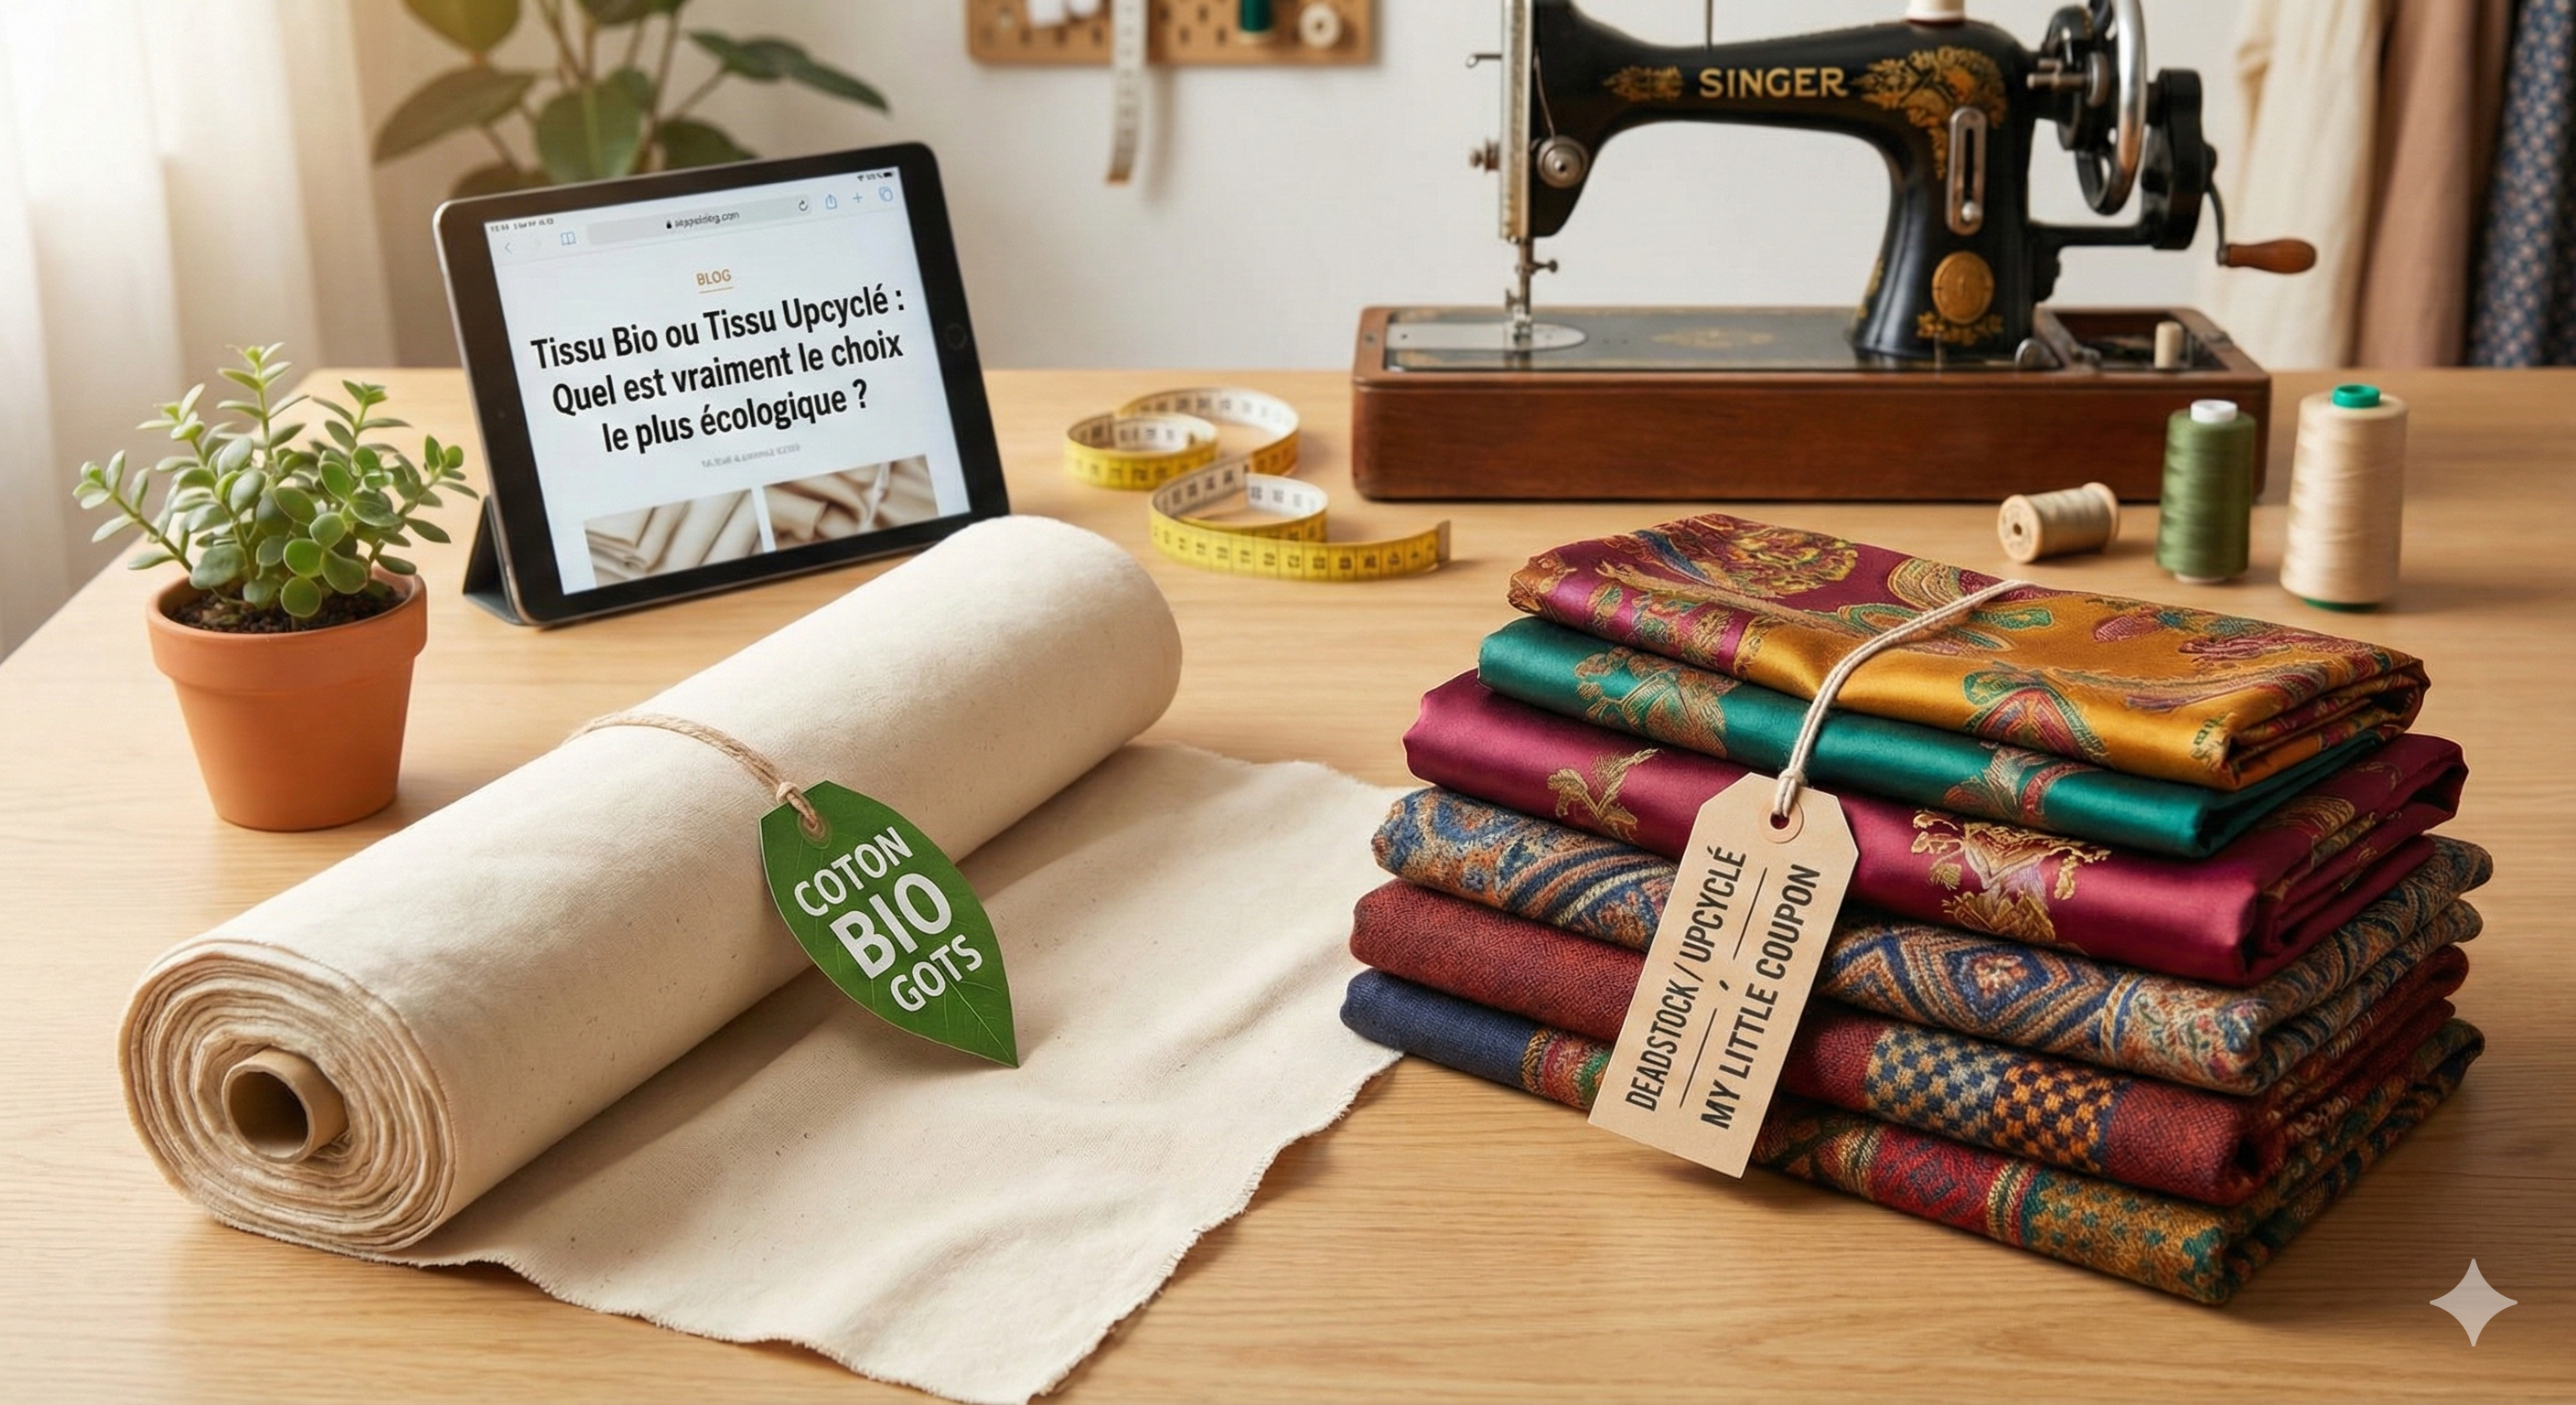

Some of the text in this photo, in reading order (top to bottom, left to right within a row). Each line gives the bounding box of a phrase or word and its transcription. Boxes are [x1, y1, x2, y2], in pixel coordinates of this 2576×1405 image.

[1699, 67, 1849, 98] SINGER
[695, 269, 732, 286] BLOG
[530, 337, 606, 370] Tissu
[611, 324, 658, 357] Bio
[665, 322, 700, 349] ou
[703, 308, 778, 341] Tissu
[781, 283, 889, 334] Upcyclé
[553, 329, 904, 417] Quel est vraiment le choix
[602, 378, 867, 455] le plus écologique ?
[793, 825, 914, 917] COTON
[829, 872, 952, 980] BIO
[889, 933, 983, 1013] GOTS
[1625, 979, 1700, 1112] DEADSTOCK
[1679, 845, 1747, 963] UPCYCLÉ
[1700, 863, 1821, 1130] MY LITTLE COUPON
